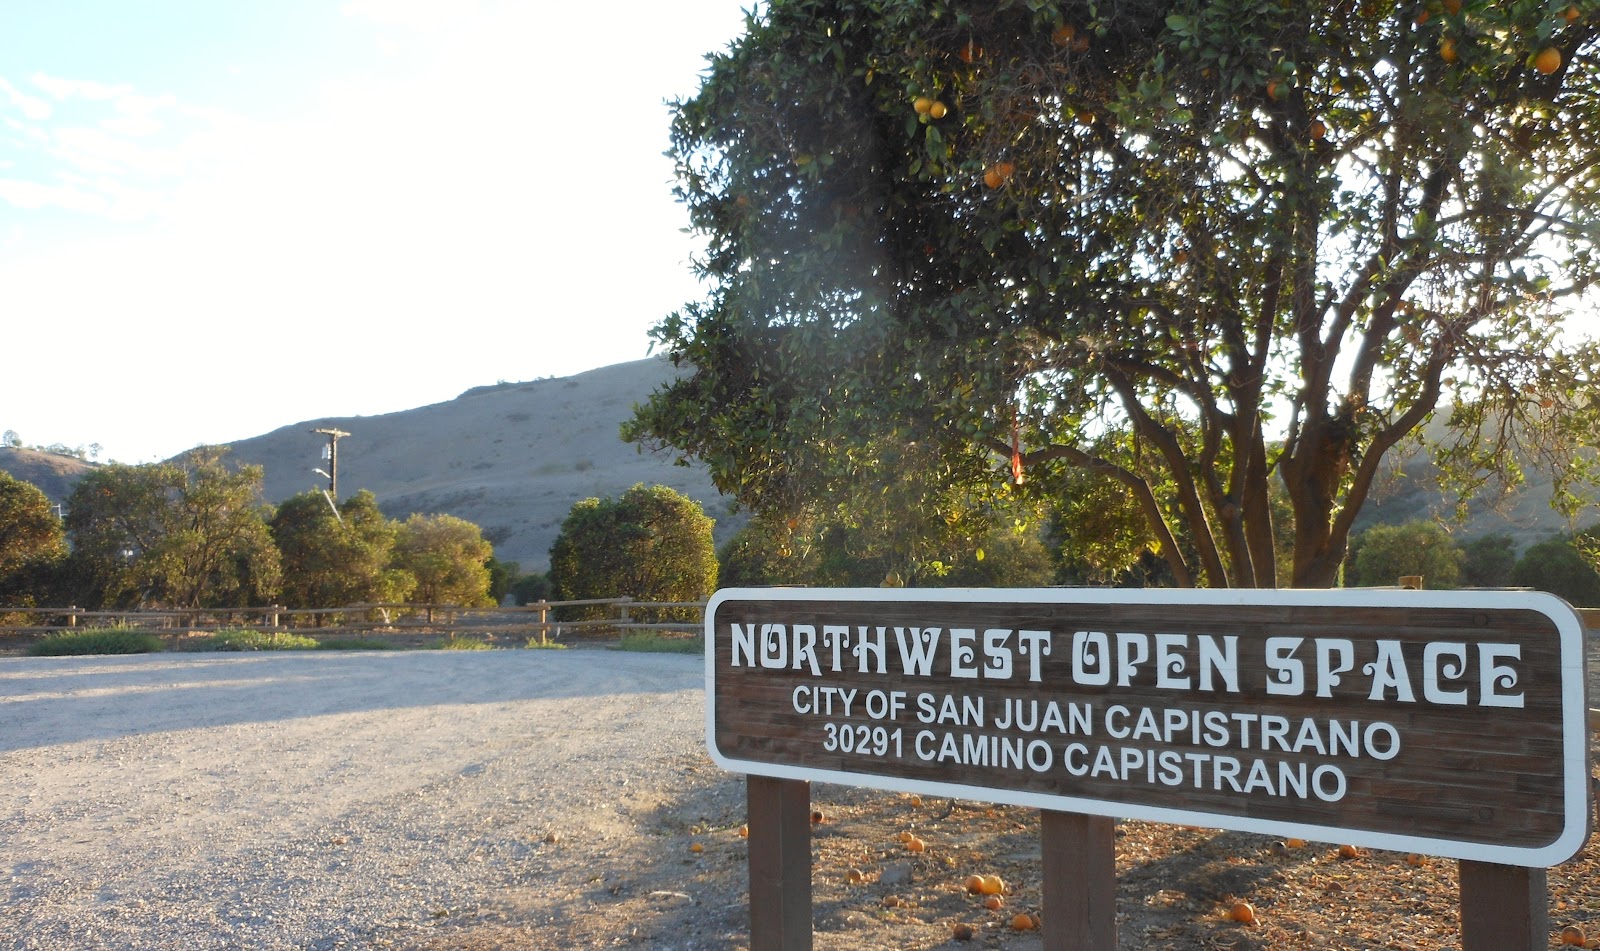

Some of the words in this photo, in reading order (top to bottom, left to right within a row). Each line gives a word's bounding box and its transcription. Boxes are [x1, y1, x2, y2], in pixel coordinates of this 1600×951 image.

[730, 623, 1052, 682] NORTHWEST
[1072, 631, 1240, 693] OPEN
[1265, 636, 1525, 708] SPACE
[792, 685, 858, 717] CITY
[865, 689, 907, 721] OF
[916, 692, 985, 728] SAN
[994, 698, 1092, 736] JUAN
[1105, 704, 1401, 761] CAPISTRANO
[823, 722, 902, 758] 30291
[915, 729, 1054, 773] CAMINO
[1064, 742, 1348, 802] CAPISTRANO
